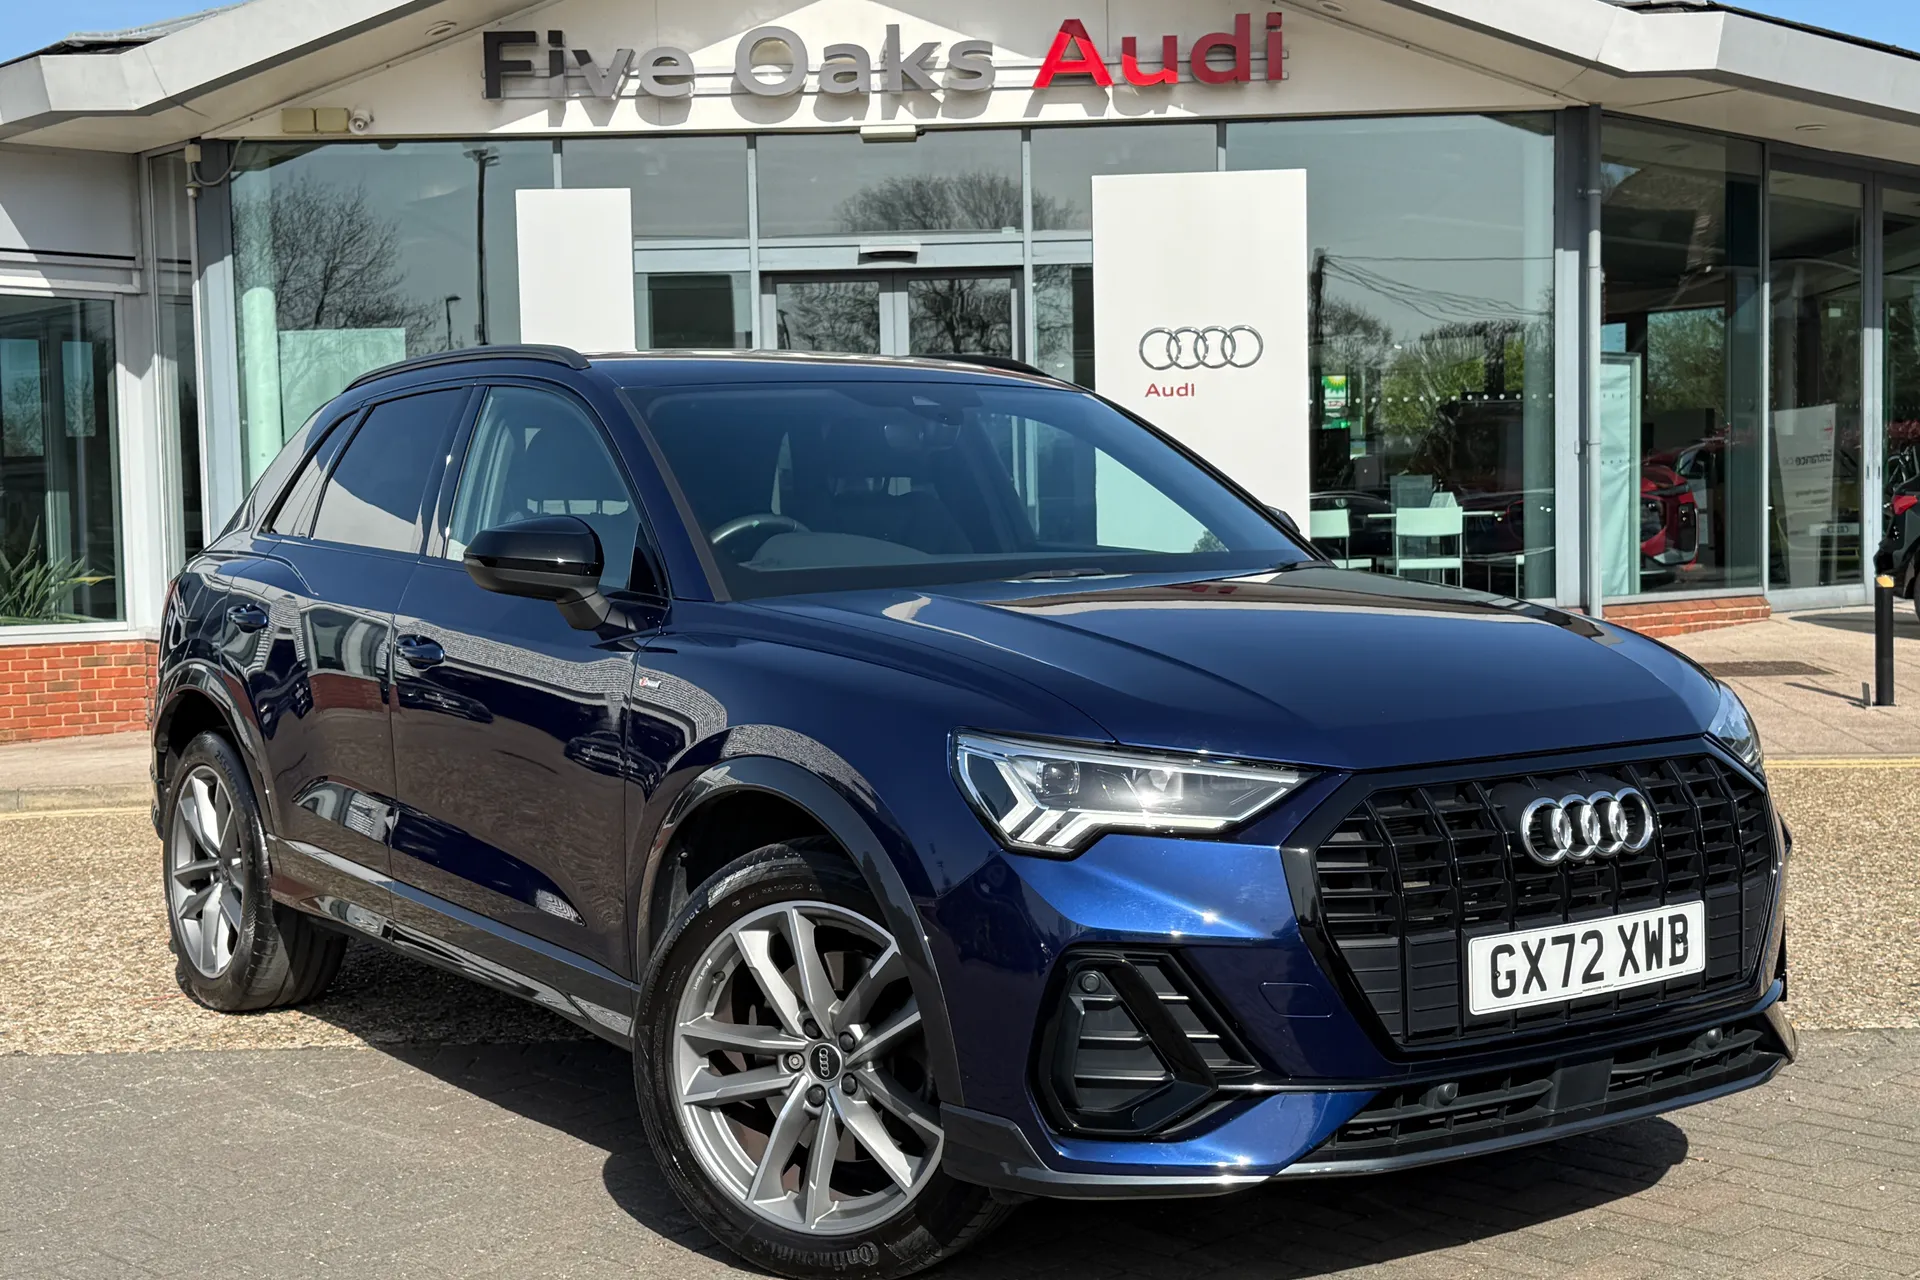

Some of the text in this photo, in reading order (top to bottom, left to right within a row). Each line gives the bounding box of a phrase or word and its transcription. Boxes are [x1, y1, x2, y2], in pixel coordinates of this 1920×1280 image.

[483, 12, 1283, 99] Five Oaks Audi
[1145, 382, 1195, 397] Audi
[1490, 913, 1689, 998] GX72 XWB
